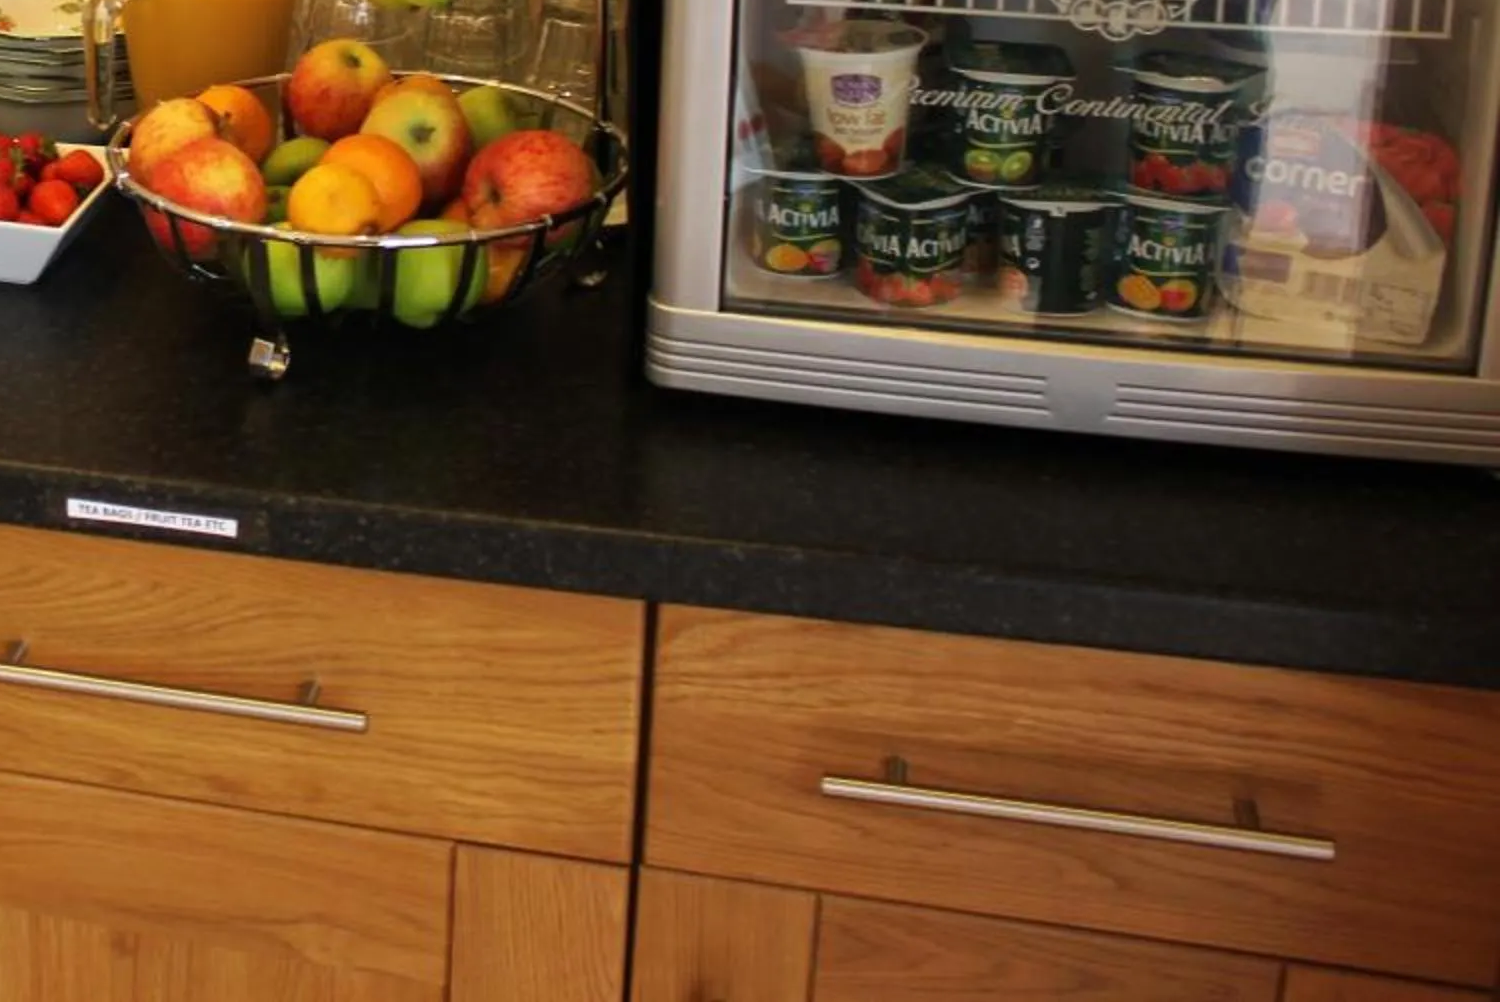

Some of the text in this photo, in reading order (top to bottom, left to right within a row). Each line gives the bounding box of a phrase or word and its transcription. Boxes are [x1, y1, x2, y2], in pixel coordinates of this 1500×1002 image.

[1035, 83, 1236, 124] Continental
[966, 108, 1043, 136] ACTIVIA
[1245, 155, 1367, 198] corner
[768, 203, 840, 229] ACTIVIA
[1127, 234, 1205, 265] ACTIVIA
[77, 503, 99, 516] TEA
[145, 511, 177, 526] FRUIT
[181, 515, 201, 528] TEA
